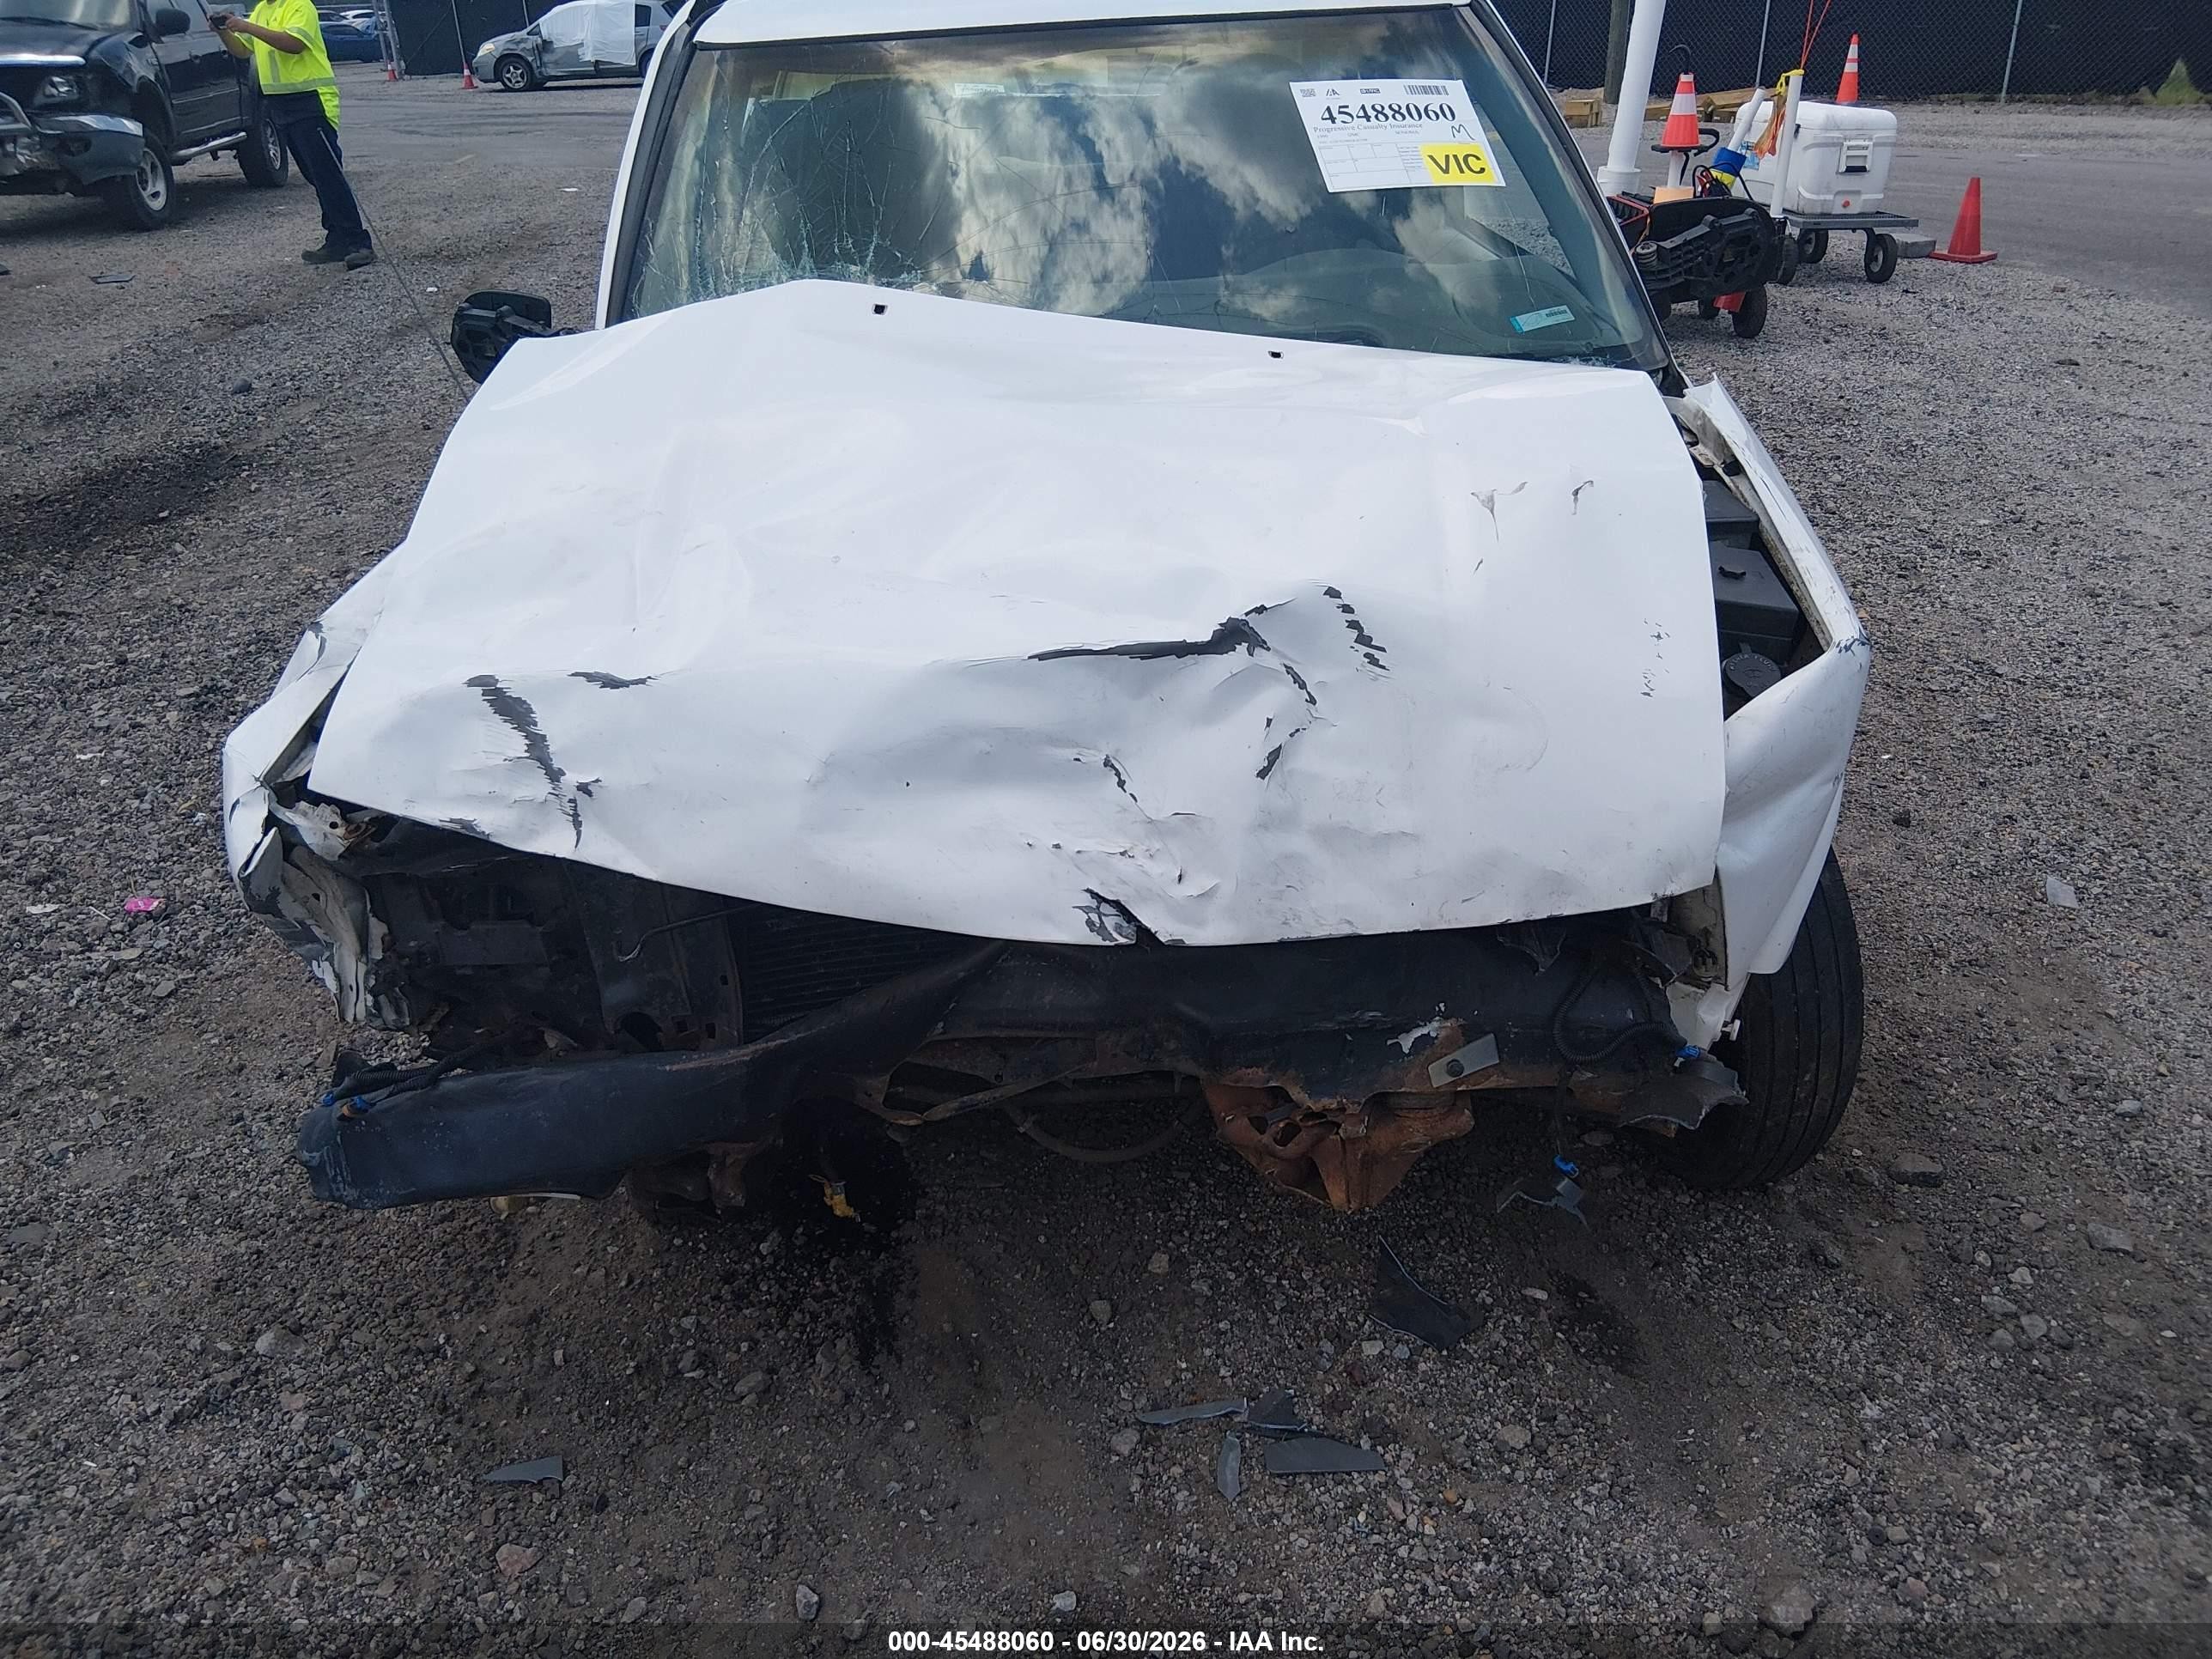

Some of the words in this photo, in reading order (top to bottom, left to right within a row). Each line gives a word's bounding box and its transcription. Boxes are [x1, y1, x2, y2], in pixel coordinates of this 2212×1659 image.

[1321, 102, 1456, 125] 45488060
[1313, 125, 1355, 134] Progressive
[1427, 153, 1486, 175] VIC
